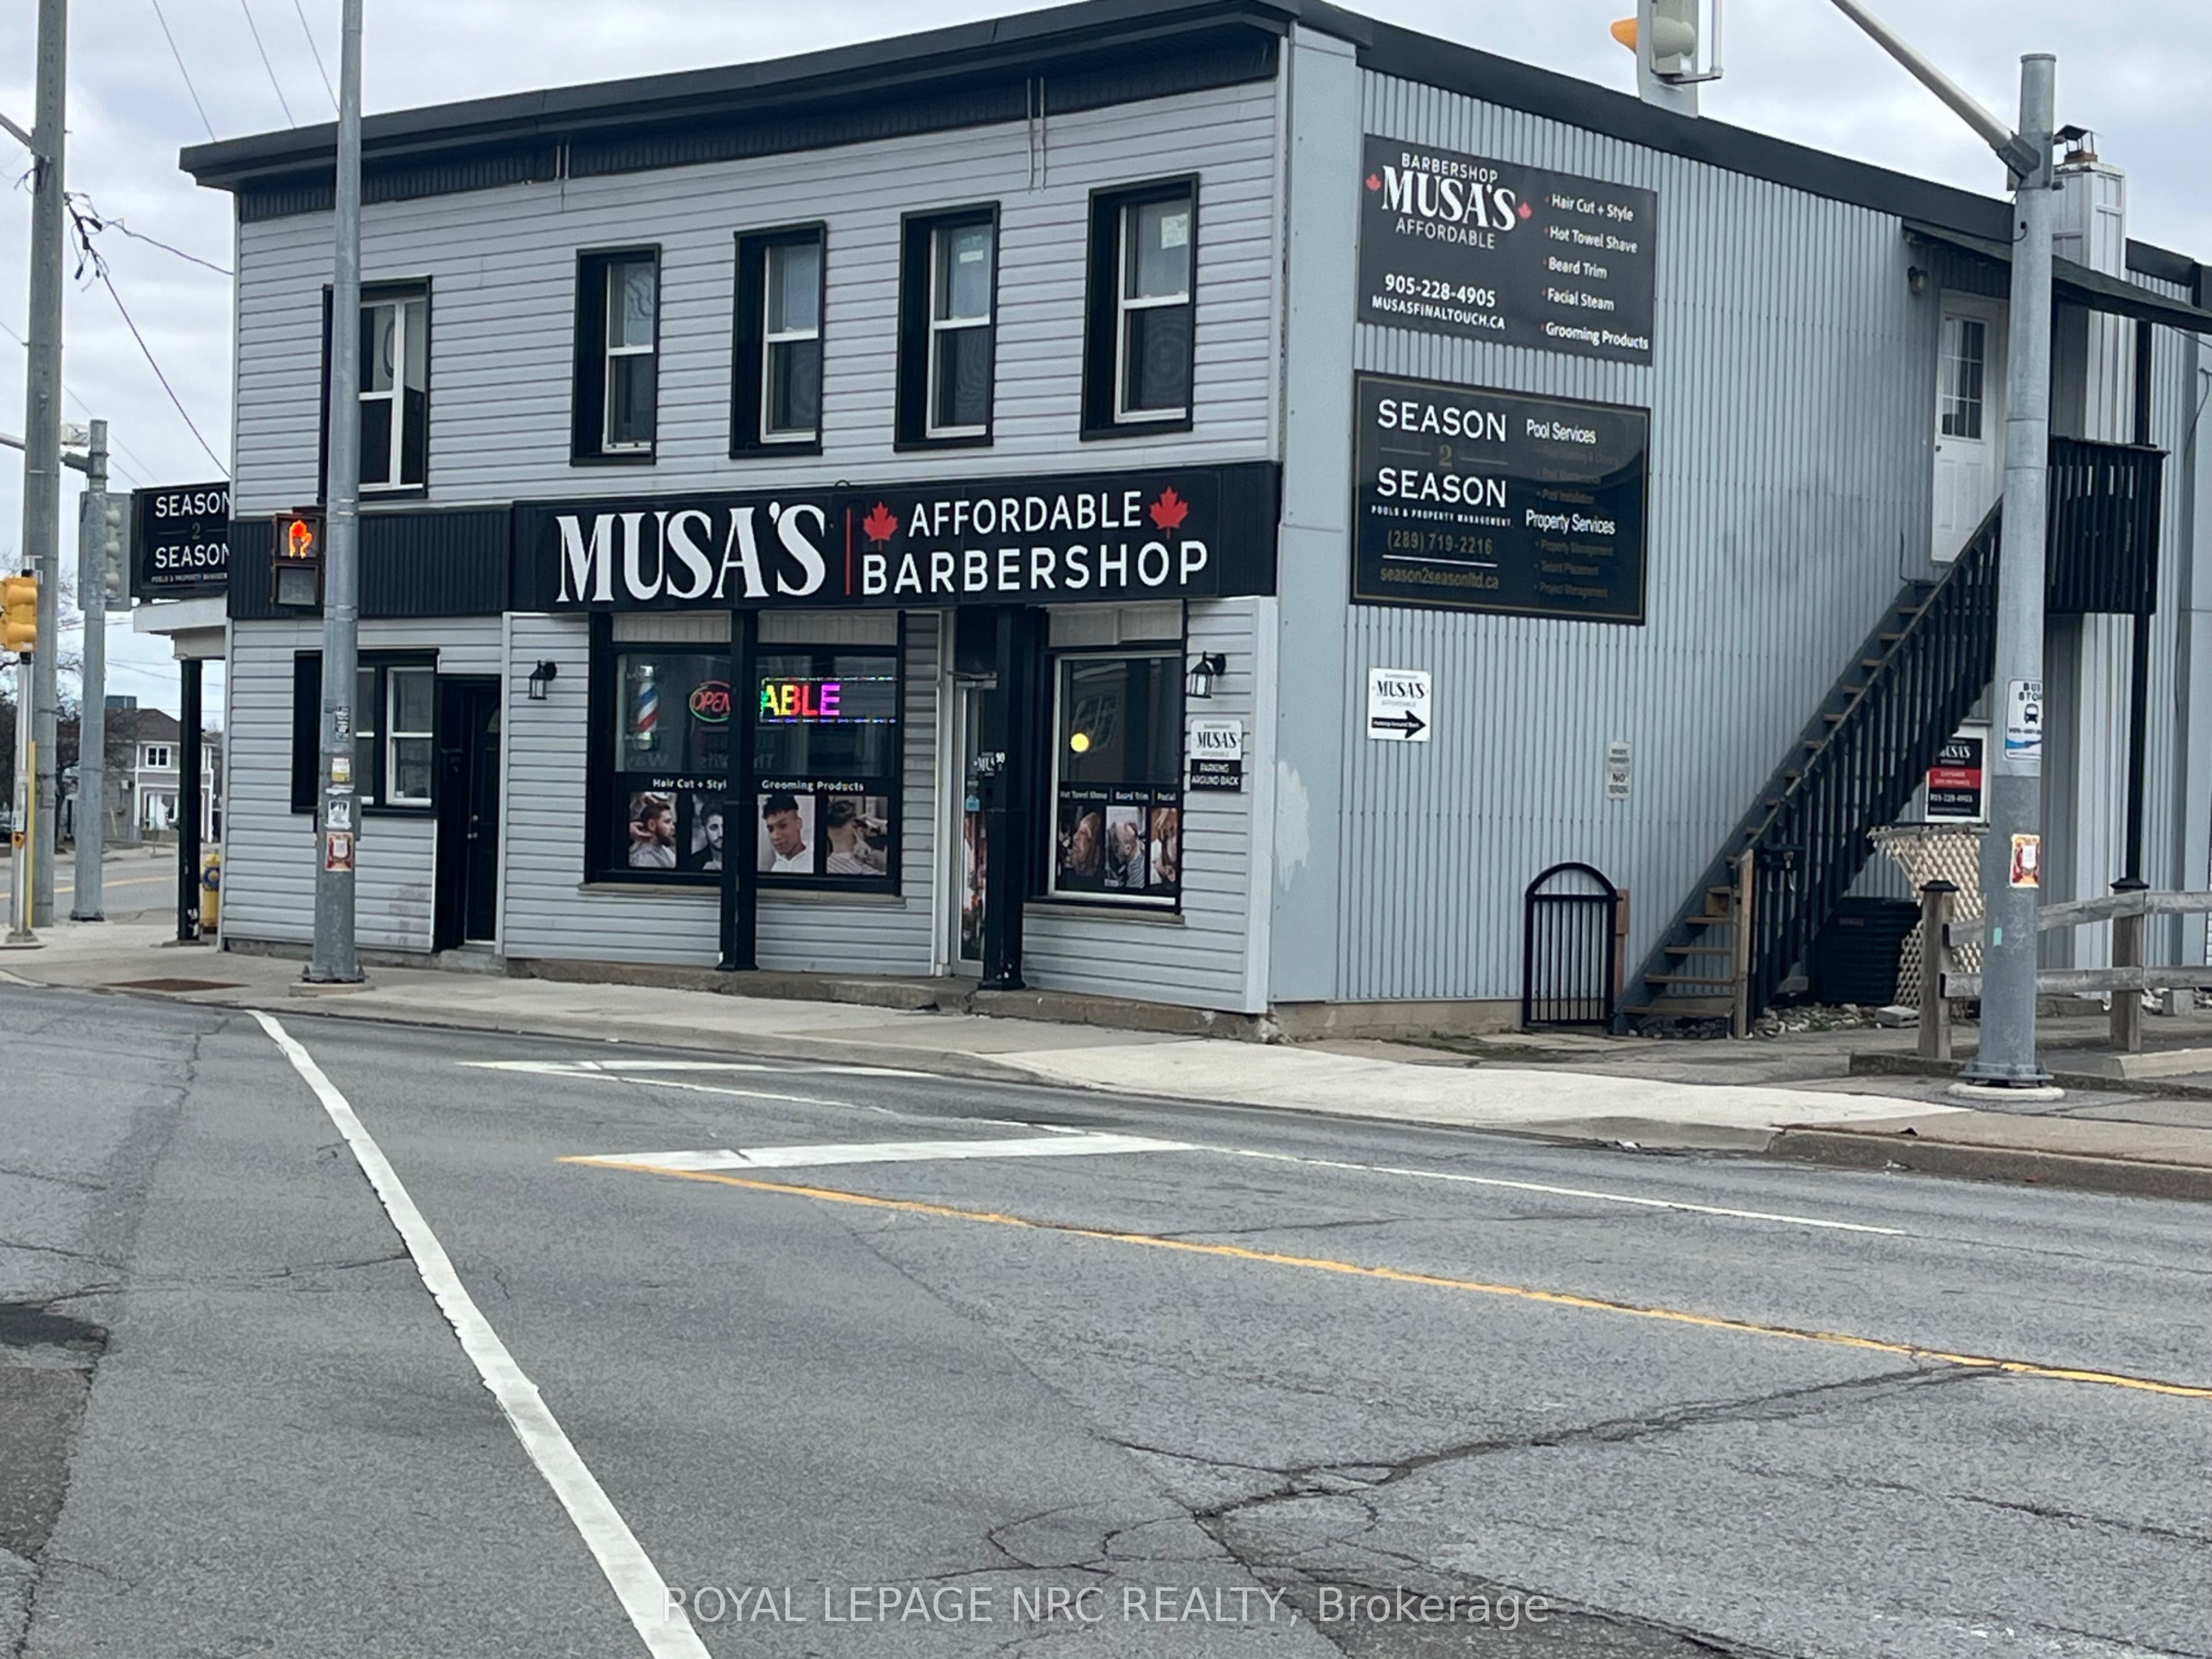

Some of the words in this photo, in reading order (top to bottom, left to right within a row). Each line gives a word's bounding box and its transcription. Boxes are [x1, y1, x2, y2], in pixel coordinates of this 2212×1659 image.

[1402, 152, 1498, 183] BARBERSHOP
[1381, 165, 1516, 231] MUSA'S
[1552, 194, 1575, 210] Hair
[1577, 199, 1595, 214] Cut
[1607, 204, 1634, 222] Style
[1395, 217, 1495, 249] AFFORDABLE
[1550, 226, 1569, 242] Hot
[1571, 229, 1604, 248] Towel
[1606, 236, 1638, 253] Shave
[1548, 257, 1580, 275] Beard
[1583, 263, 1607, 279] Trim
[1385, 274, 1495, 307] 905-228-4905
[1548, 288, 1578, 305] Facial
[1581, 294, 1615, 310] Steam
[1372, 295, 1505, 330] MUSASFINALTOUCH.CA
[1546, 321, 1600, 346] Grooming
[1602, 330, 1649, 350] Products
[1378, 399, 1506, 442] SEASON
[1527, 419, 1550, 440] Pool
[1552, 422, 1597, 444] Services
[1439, 444, 1453, 467] 2
[1377, 467, 1506, 508] SEASON
[908, 490, 1142, 537] AFFORDABLE
[1371, 505, 1399, 516] POOLS
[1412, 509, 1454, 521] PROPERTY
[1525, 509, 1570, 535] Property
[1572, 513, 1615, 535] Services
[191, 522, 201, 540] 2
[1387, 529, 1425, 553] (289)
[1429, 533, 1493, 555] 719-2216
[555, 501, 826, 603] MUSA'S
[862, 540, 1208, 596] BARBERSHOP
[761, 685, 840, 715] ABLE
[653, 778, 674, 789] Hair
[677, 778, 695, 789] Cut
[707, 779, 727, 791] Styl
[762, 779, 815, 793] Grooming
[817, 780, 864, 791] Products
